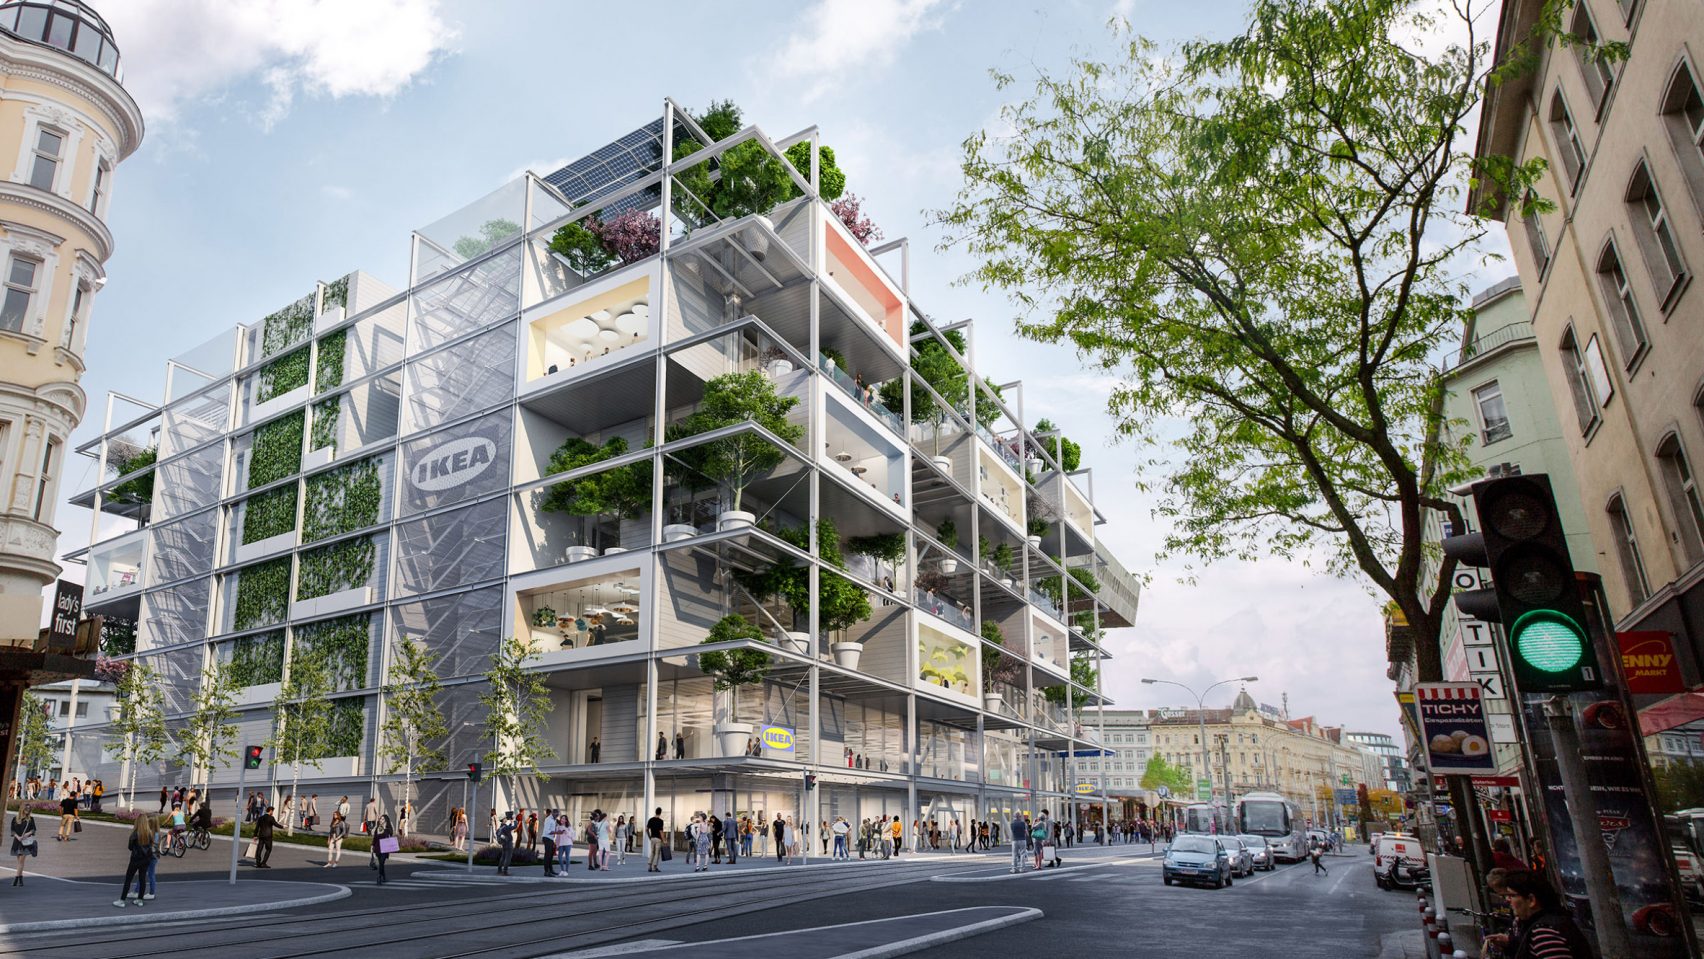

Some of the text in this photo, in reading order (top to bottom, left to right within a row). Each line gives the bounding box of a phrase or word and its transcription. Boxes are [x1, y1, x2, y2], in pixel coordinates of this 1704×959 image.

[418, 443, 490, 483] IKEA
[58, 592, 80, 615] lady's
[55, 613, 76, 636] first
[1455, 573, 1497, 696] OTIK
[1622, 654, 1672, 668] ENNY
[1422, 704, 1479, 714] TICHY
[765, 731, 791, 744] IKEA
